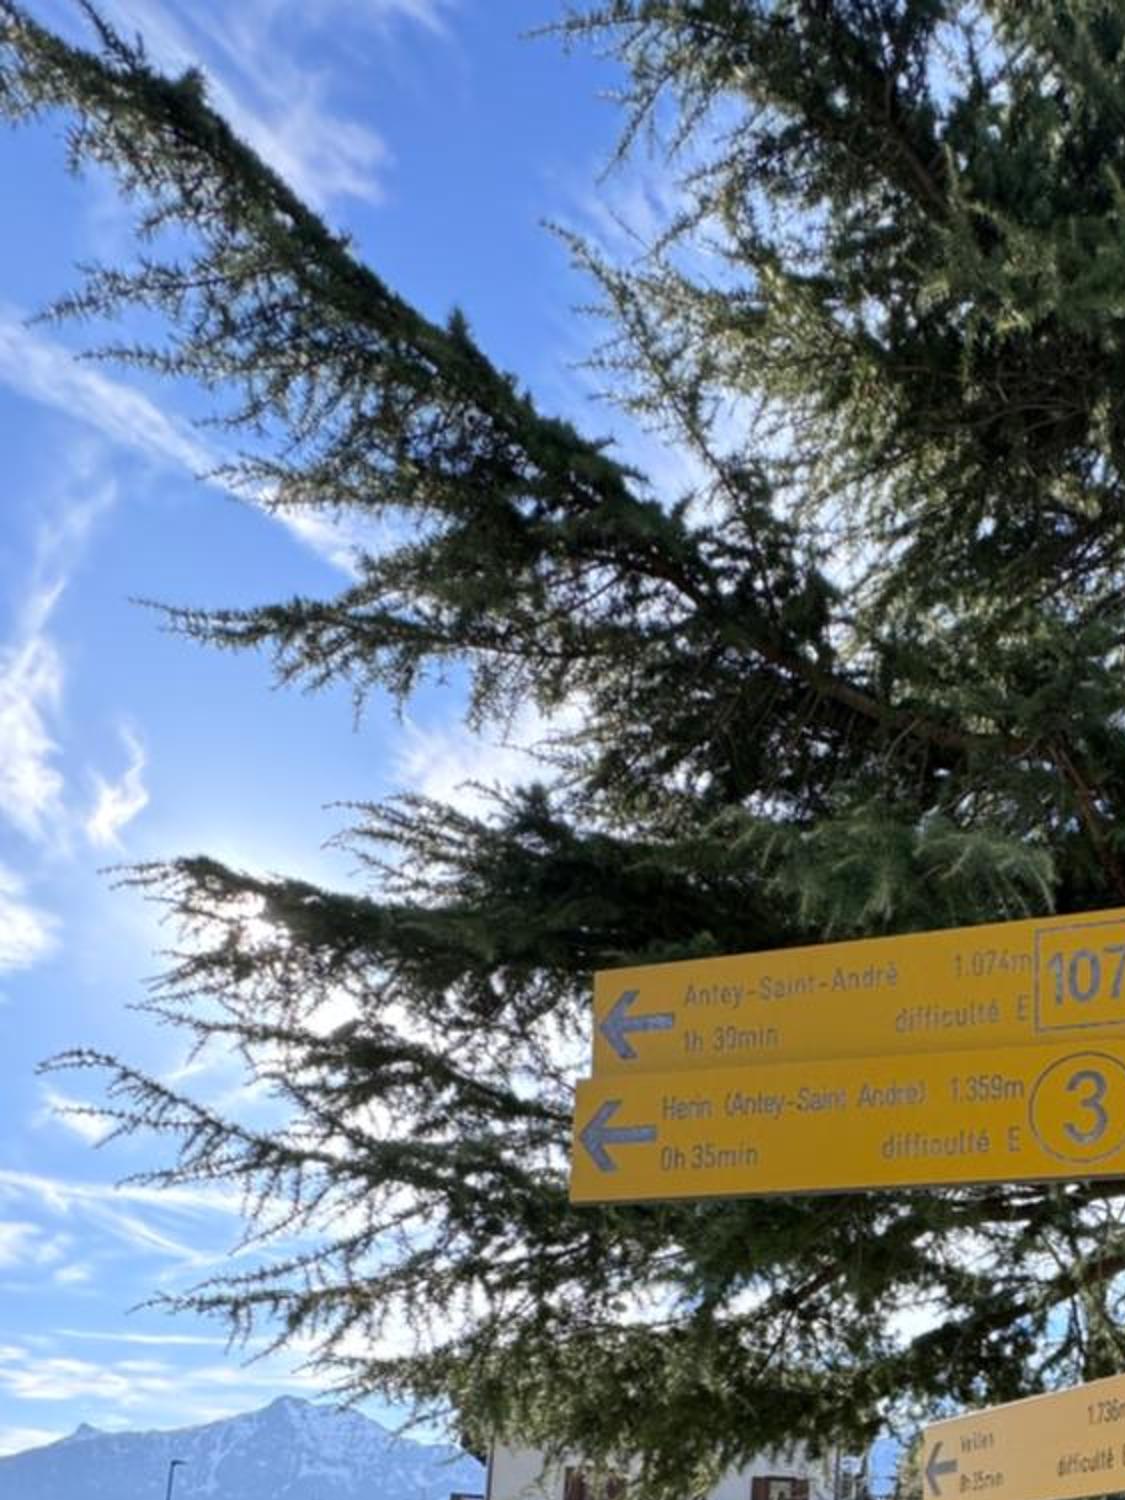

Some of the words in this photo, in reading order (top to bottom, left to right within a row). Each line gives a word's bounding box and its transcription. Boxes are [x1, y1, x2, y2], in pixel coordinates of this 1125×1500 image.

[1016, 993, 1030, 1021] E
[950, 1076, 1025, 1105] 1.359m
[1063, 1069, 1109, 1144] 3
[1007, 1126, 1022, 1152] E
[691, 1143, 759, 1169] 35min
